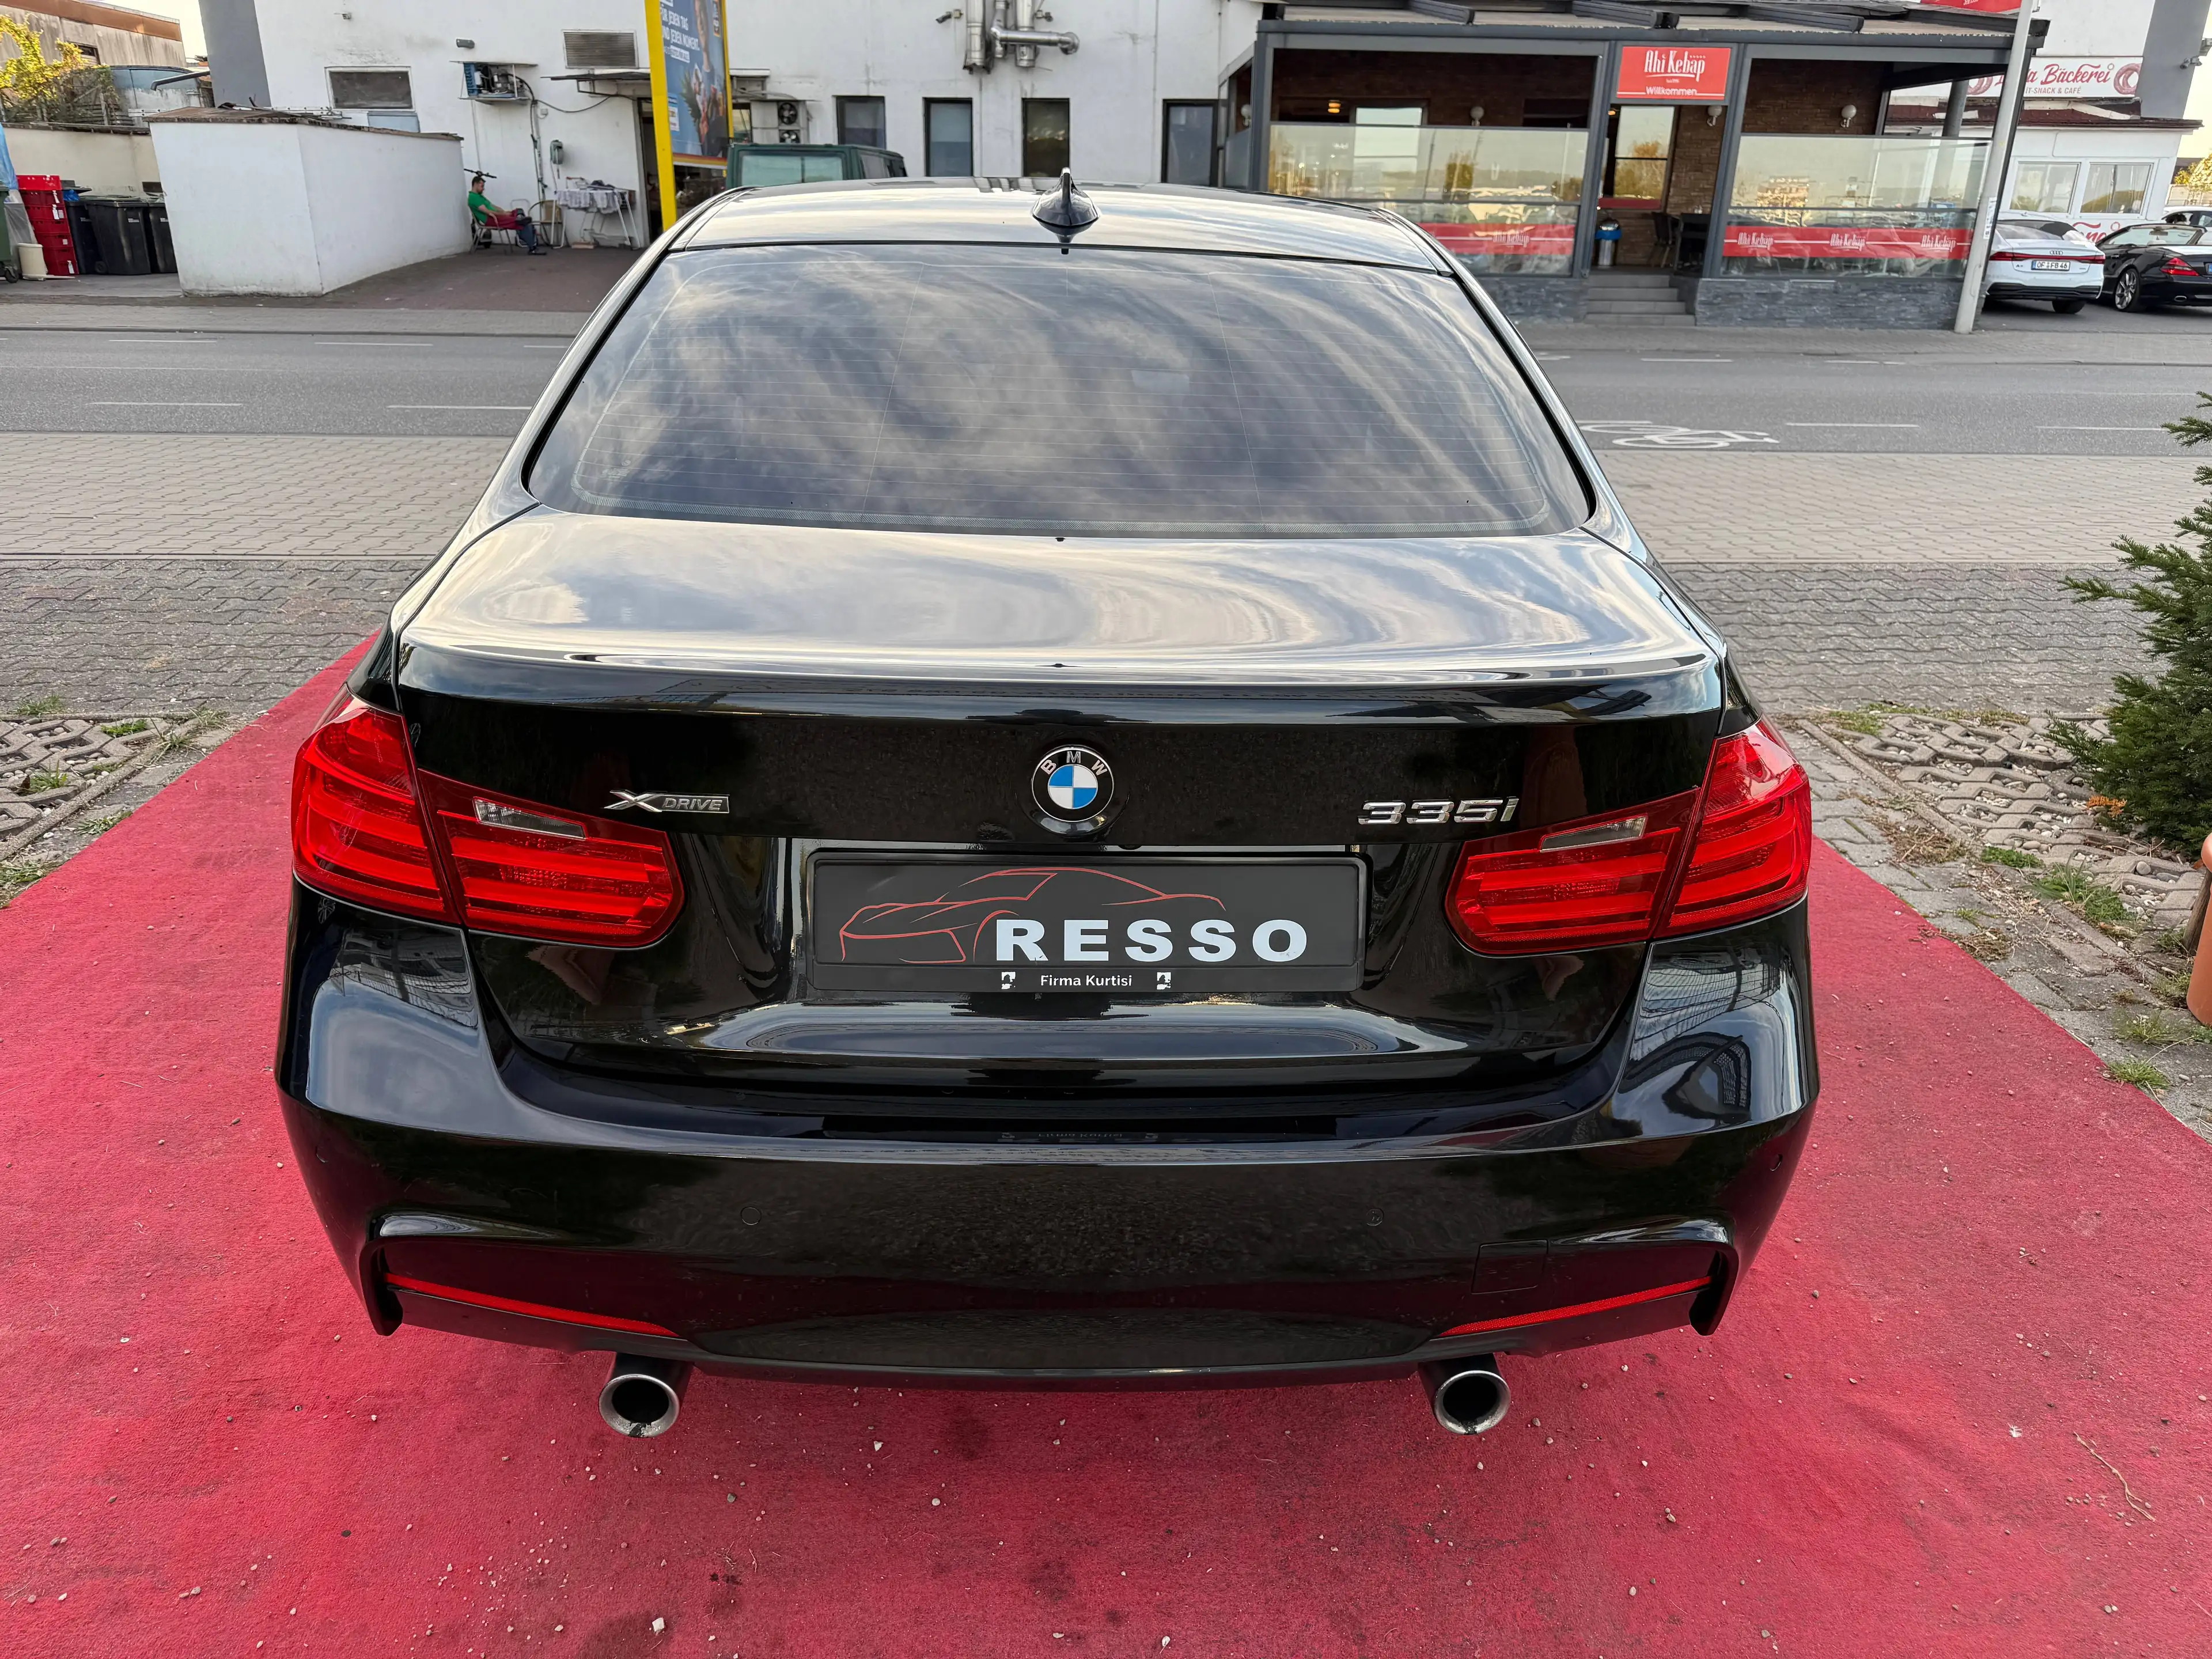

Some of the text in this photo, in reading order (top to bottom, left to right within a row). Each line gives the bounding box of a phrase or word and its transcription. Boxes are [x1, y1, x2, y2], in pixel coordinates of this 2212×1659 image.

[1643, 50, 1706, 82] Ahi Kebap
[2040, 63, 2115, 85] Bäckerei
[1646, 86, 1698, 96] Willkommen
[2064, 86, 2081, 94] CAFÉ
[1040, 751, 1108, 776] BMW
[1358, 798, 1519, 824] 335i
[996, 919, 1308, 963] RESSO
[1040, 975, 1132, 986] Firma Kurtisi
